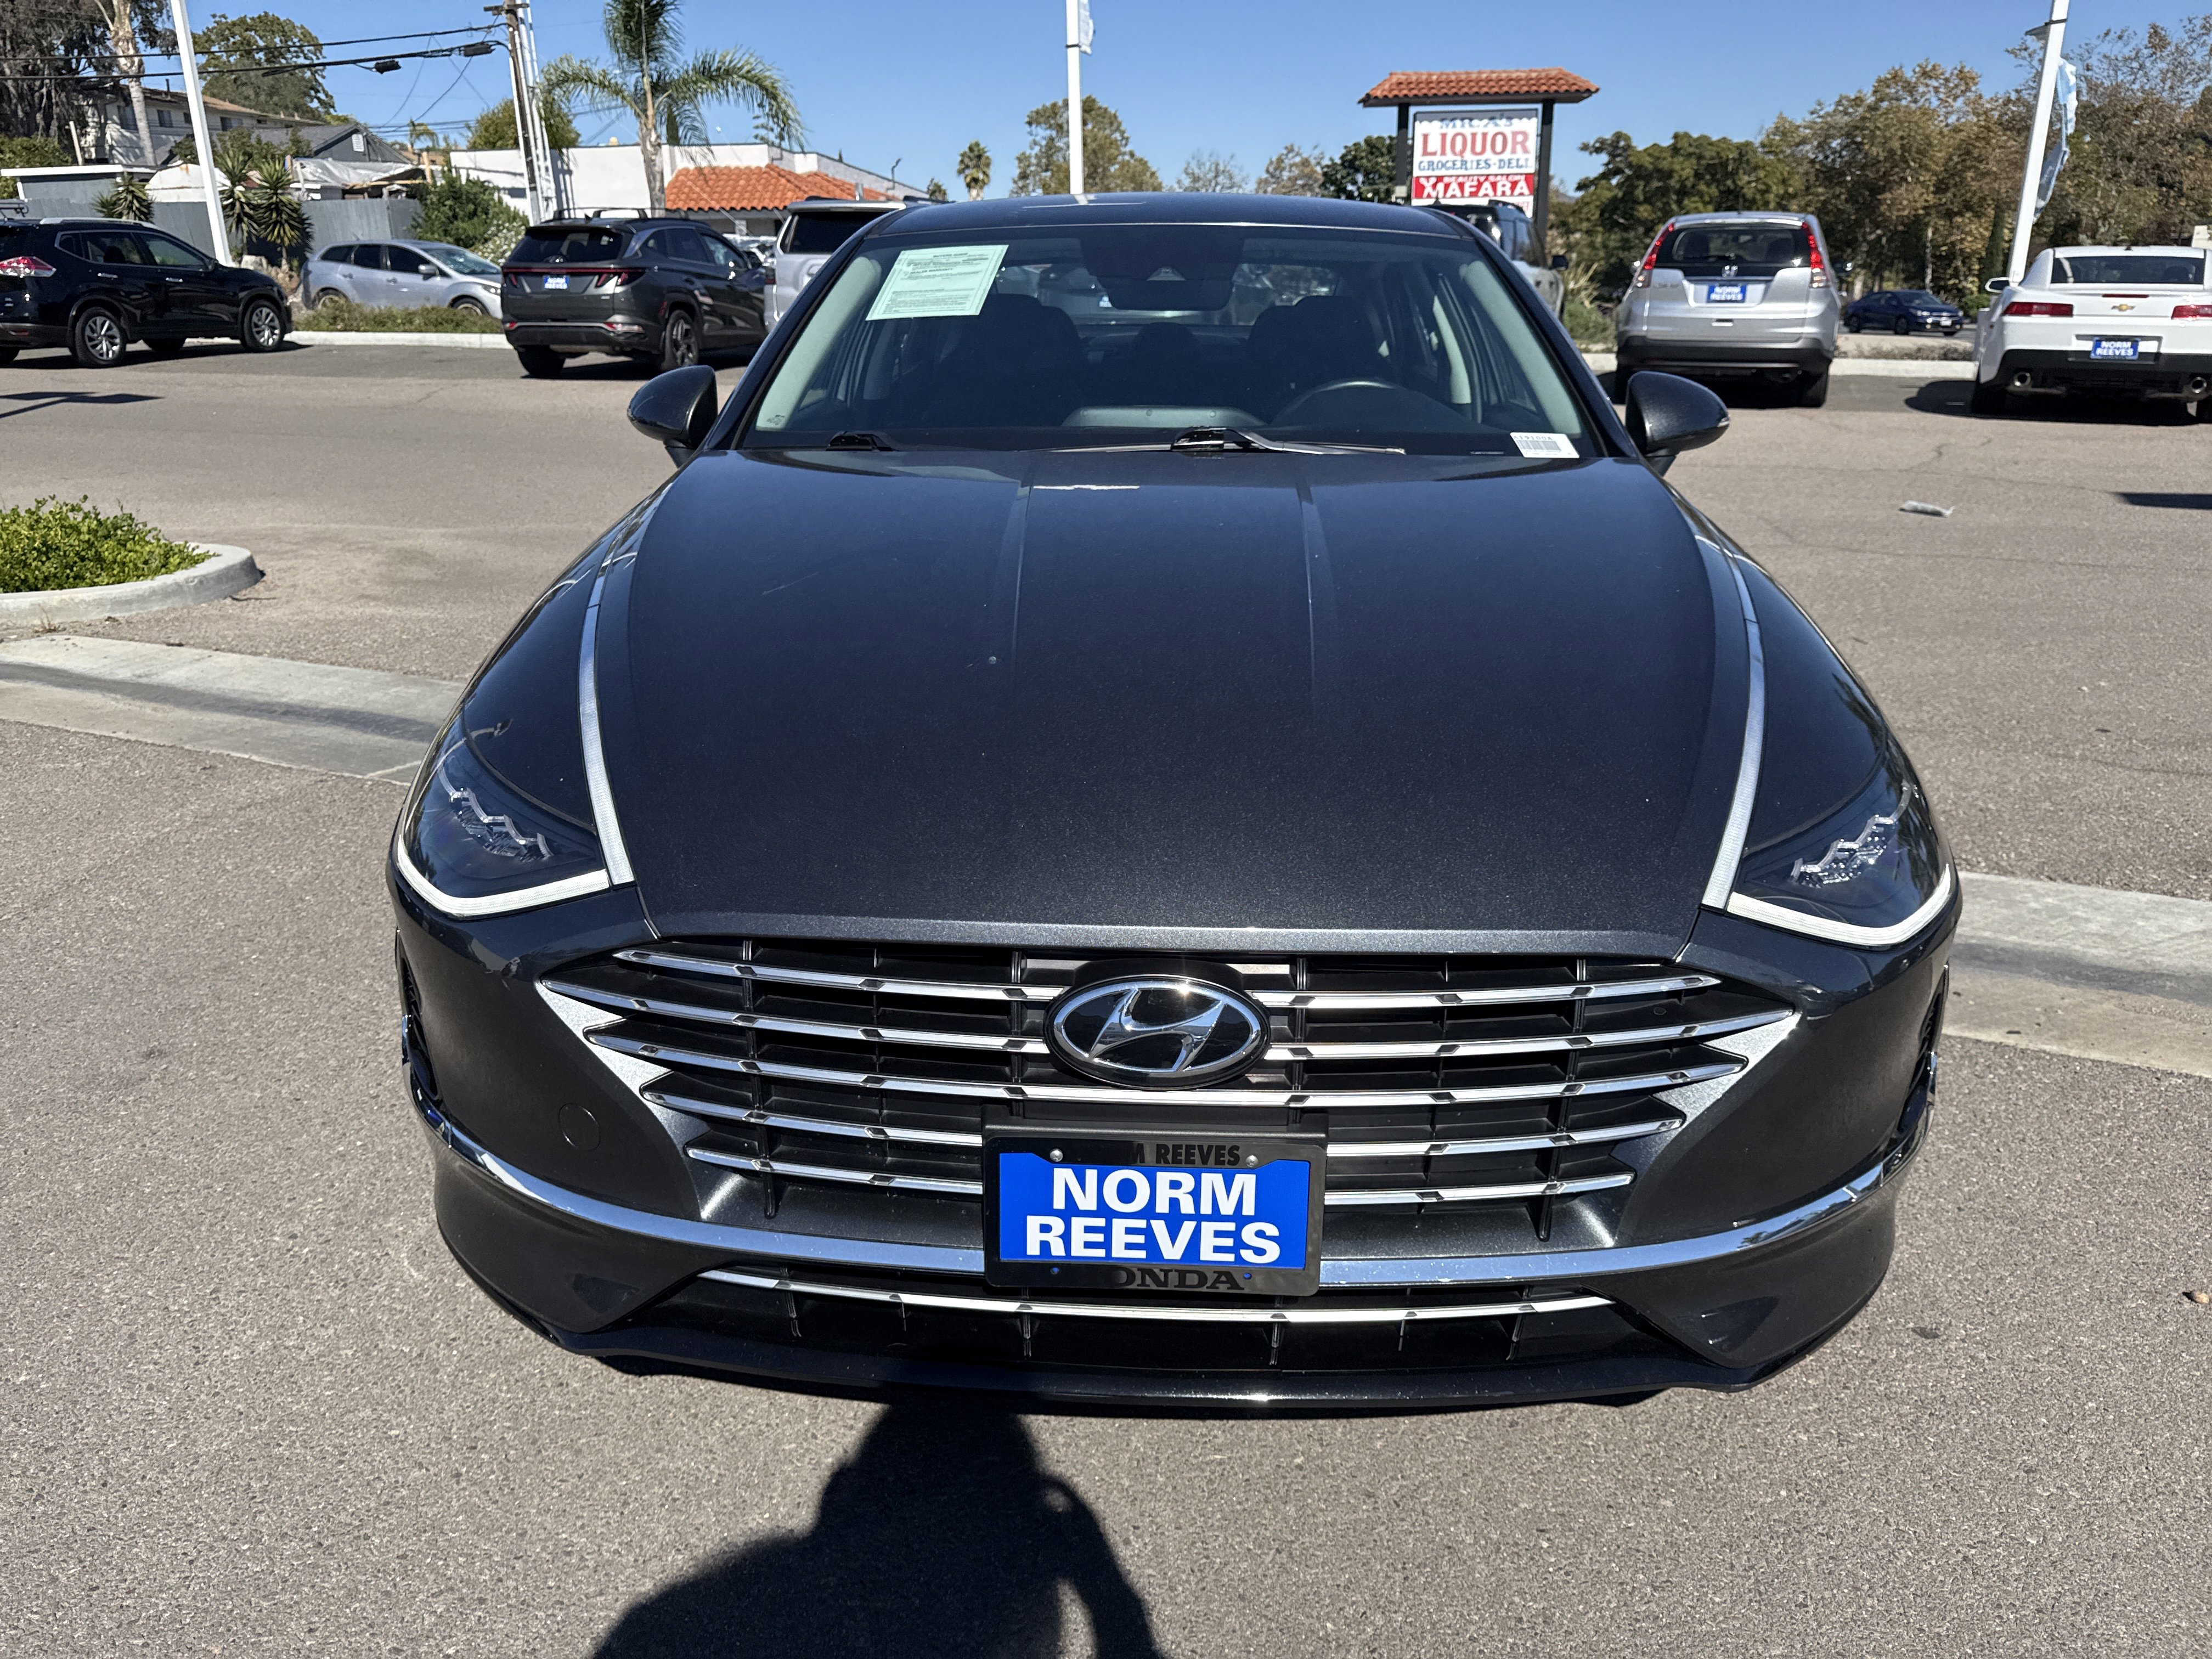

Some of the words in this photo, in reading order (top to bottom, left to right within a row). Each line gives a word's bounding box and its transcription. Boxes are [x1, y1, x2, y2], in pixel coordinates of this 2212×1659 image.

[1421, 131, 1530, 158] LIQUOR
[2096, 348, 2134, 356] REEVES
[1155, 1143, 1240, 1166] REEVES
[1053, 1167, 1256, 1216] NORM
[1026, 1215, 1281, 1264] REEVES
[1094, 1266, 1245, 1291] ONDA
